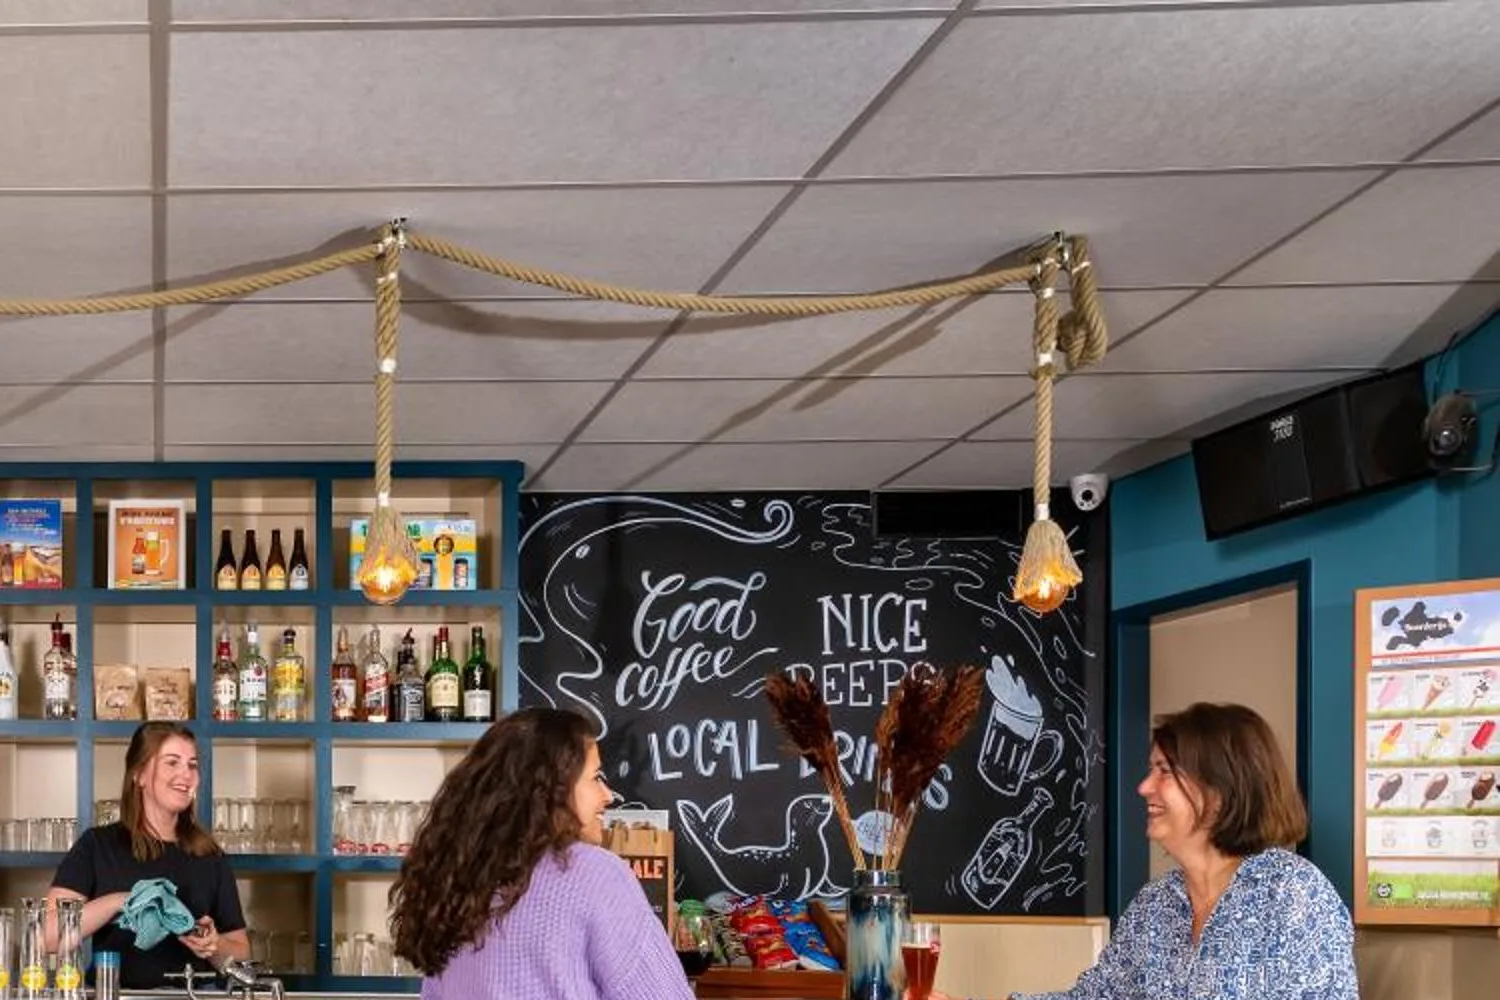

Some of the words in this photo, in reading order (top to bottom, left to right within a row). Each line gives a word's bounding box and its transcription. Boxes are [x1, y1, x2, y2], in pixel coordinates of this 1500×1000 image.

[633, 571, 767, 659] Good
[818, 592, 928, 655] NICE
[615, 642, 779, 711] coffee
[647, 719, 780, 781] LOCAL
